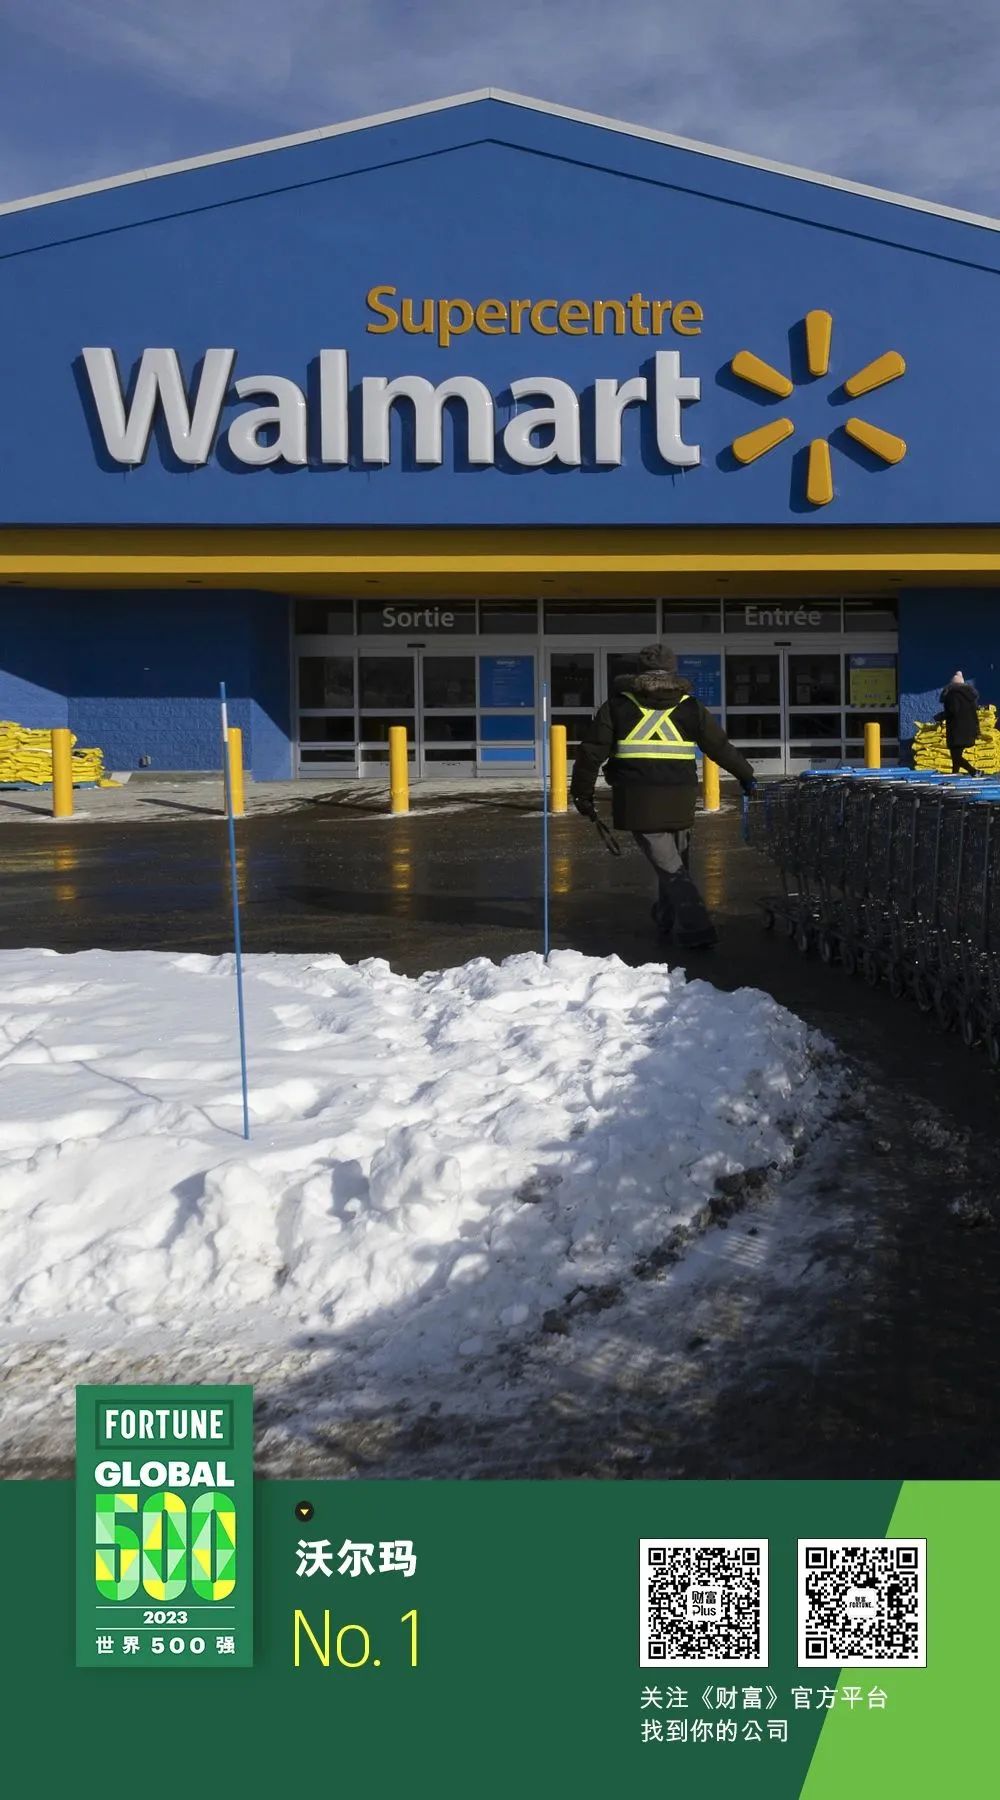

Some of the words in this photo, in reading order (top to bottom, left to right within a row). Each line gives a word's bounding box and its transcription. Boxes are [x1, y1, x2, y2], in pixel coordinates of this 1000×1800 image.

[366, 285, 704, 347] Supercentre
[82, 347, 702, 467] Walmart
[382, 606, 455, 628] Sortie
[744, 605, 822, 627] Entrée
